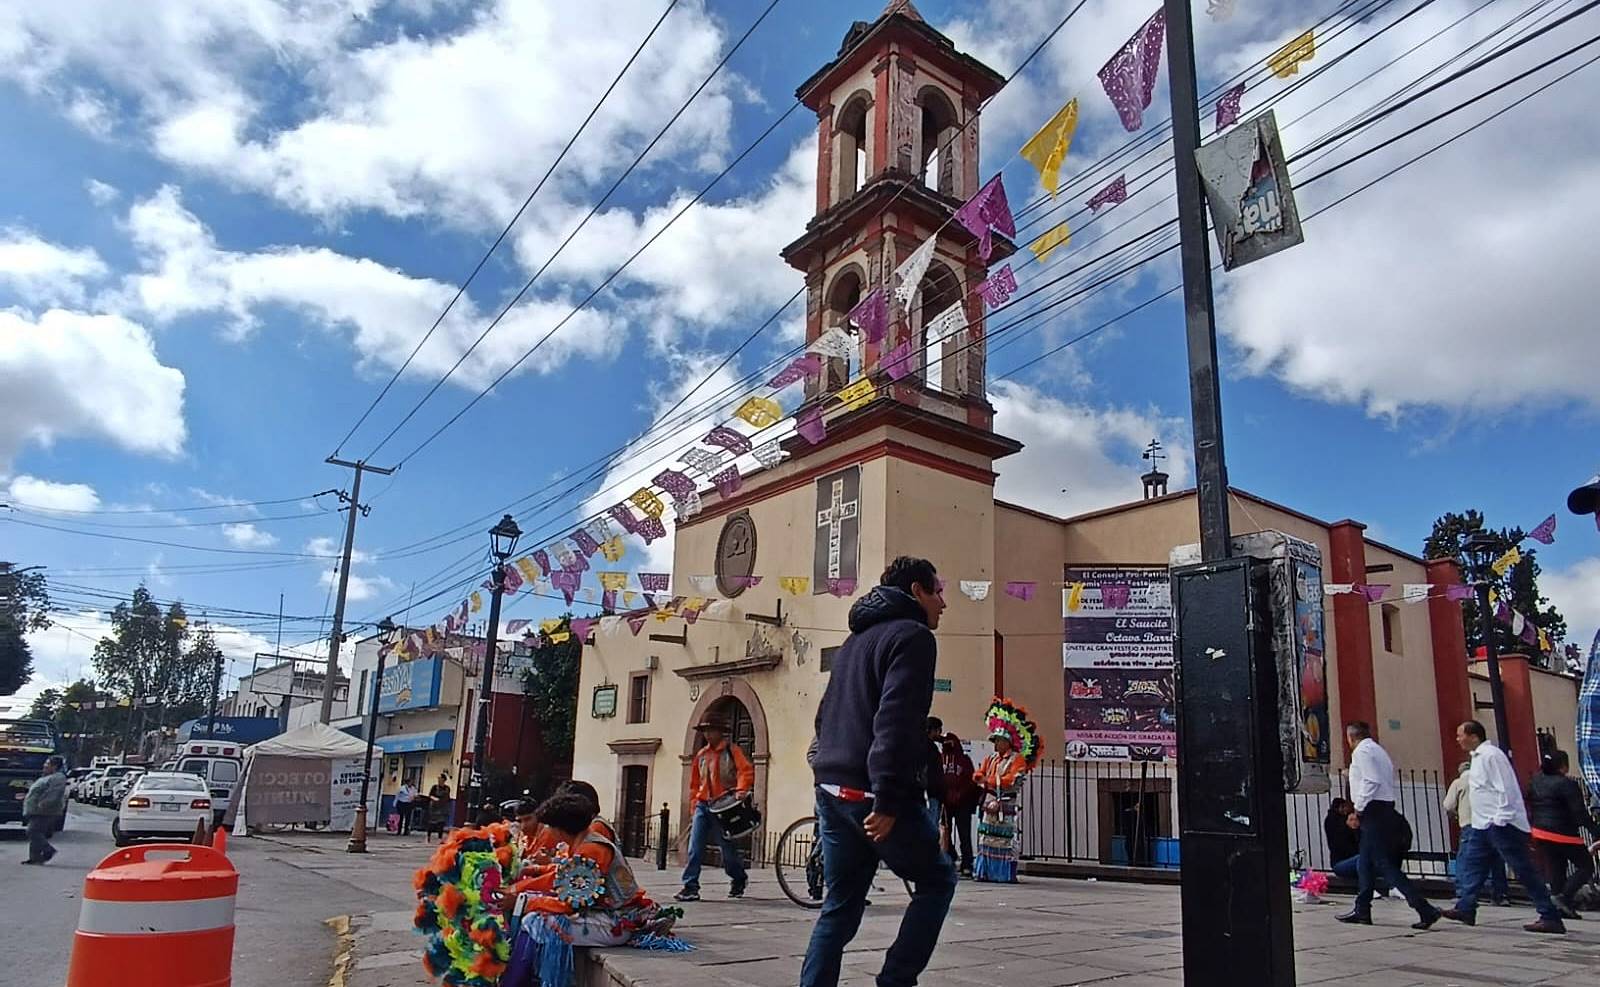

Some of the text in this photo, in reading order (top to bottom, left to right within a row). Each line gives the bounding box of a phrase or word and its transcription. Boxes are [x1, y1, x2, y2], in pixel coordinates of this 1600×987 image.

[1092, 571, 1124, 580] Consejo
[1115, 618, 1168, 628] El Saucito
[1106, 632, 1173, 642] Octavo Barri
